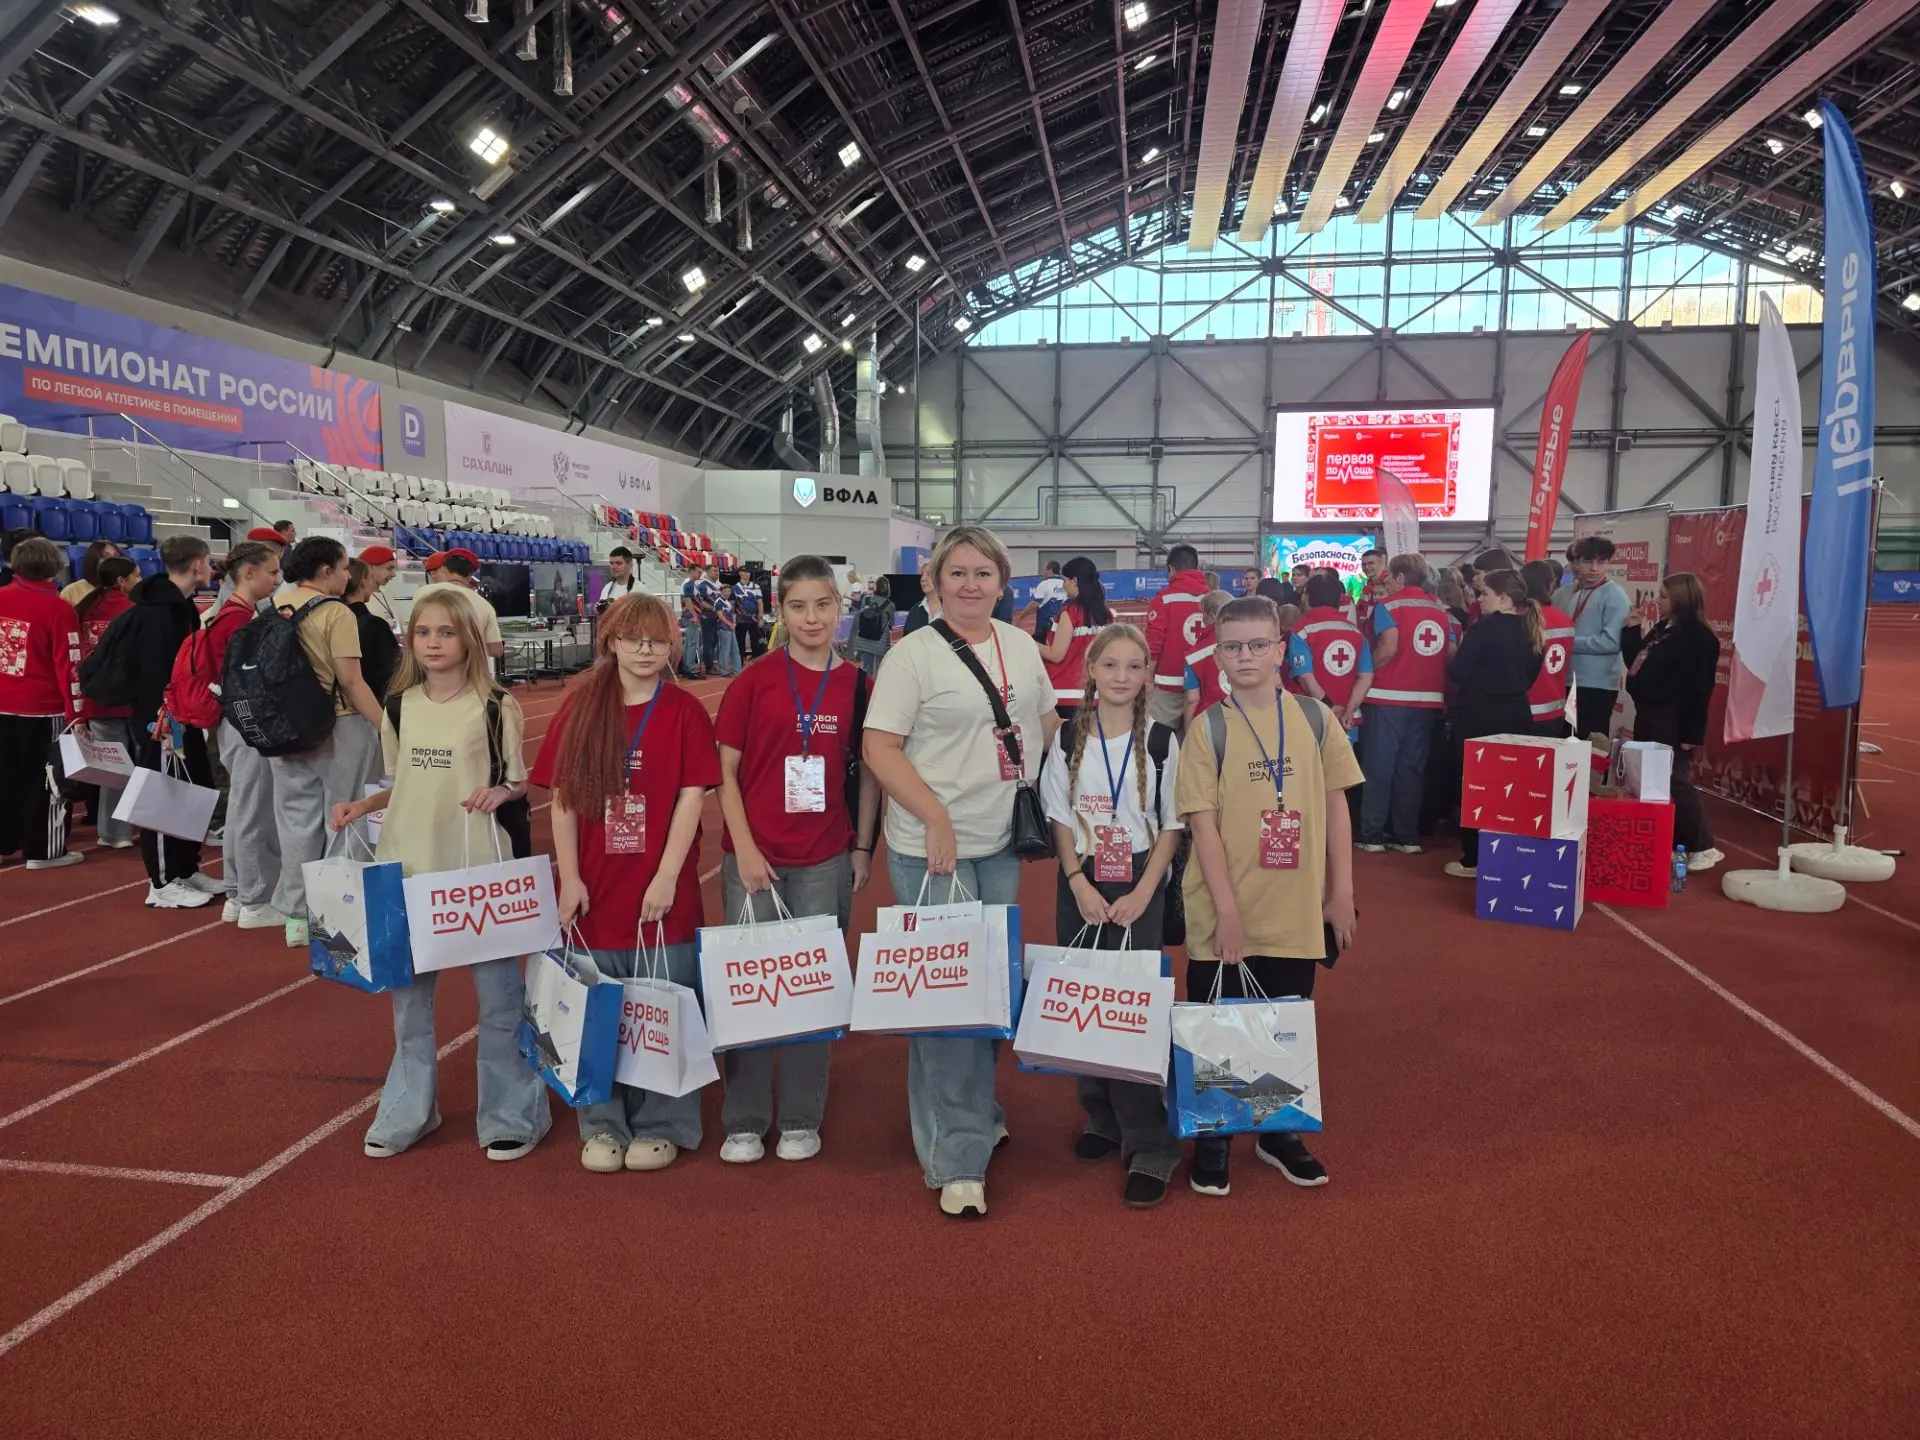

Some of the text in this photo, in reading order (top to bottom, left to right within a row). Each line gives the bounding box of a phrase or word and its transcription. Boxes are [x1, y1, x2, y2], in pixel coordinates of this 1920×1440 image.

[32, 377, 237, 425] ПО ЛЕГКОЙ АТЛЕТИКЕ В ПОМЕЩЕНИИ
[219, 373, 333, 423] РОССИИ
[405, 412, 419, 438] D
[462, 455, 513, 476] САХАЛИН
[1325, 464, 1374, 484] помощь
[1326, 453, 1374, 467] первая
[1529, 404, 1563, 529] Первые
[629, 475, 652, 492] ВФЛА
[823, 487, 878, 505] ВФЛА
[1292, 550, 1357, 564] Безопасность
[796, 721, 838, 735] пмощь
[411, 756, 452, 769] помощь
[412, 747, 452, 758] первая
[430, 875, 536, 907] первая
[432, 898, 541, 936] помощь
[726, 947, 828, 979] первая
[876, 941, 969, 969] первая
[729, 969, 834, 1007] помощь
[872, 964, 968, 999] помощь
[1047, 977, 1151, 1008] первая
[623, 999, 669, 1027] ервая
[1040, 998, 1148, 1032] помощь
[618, 1022, 669, 1055] омощь
